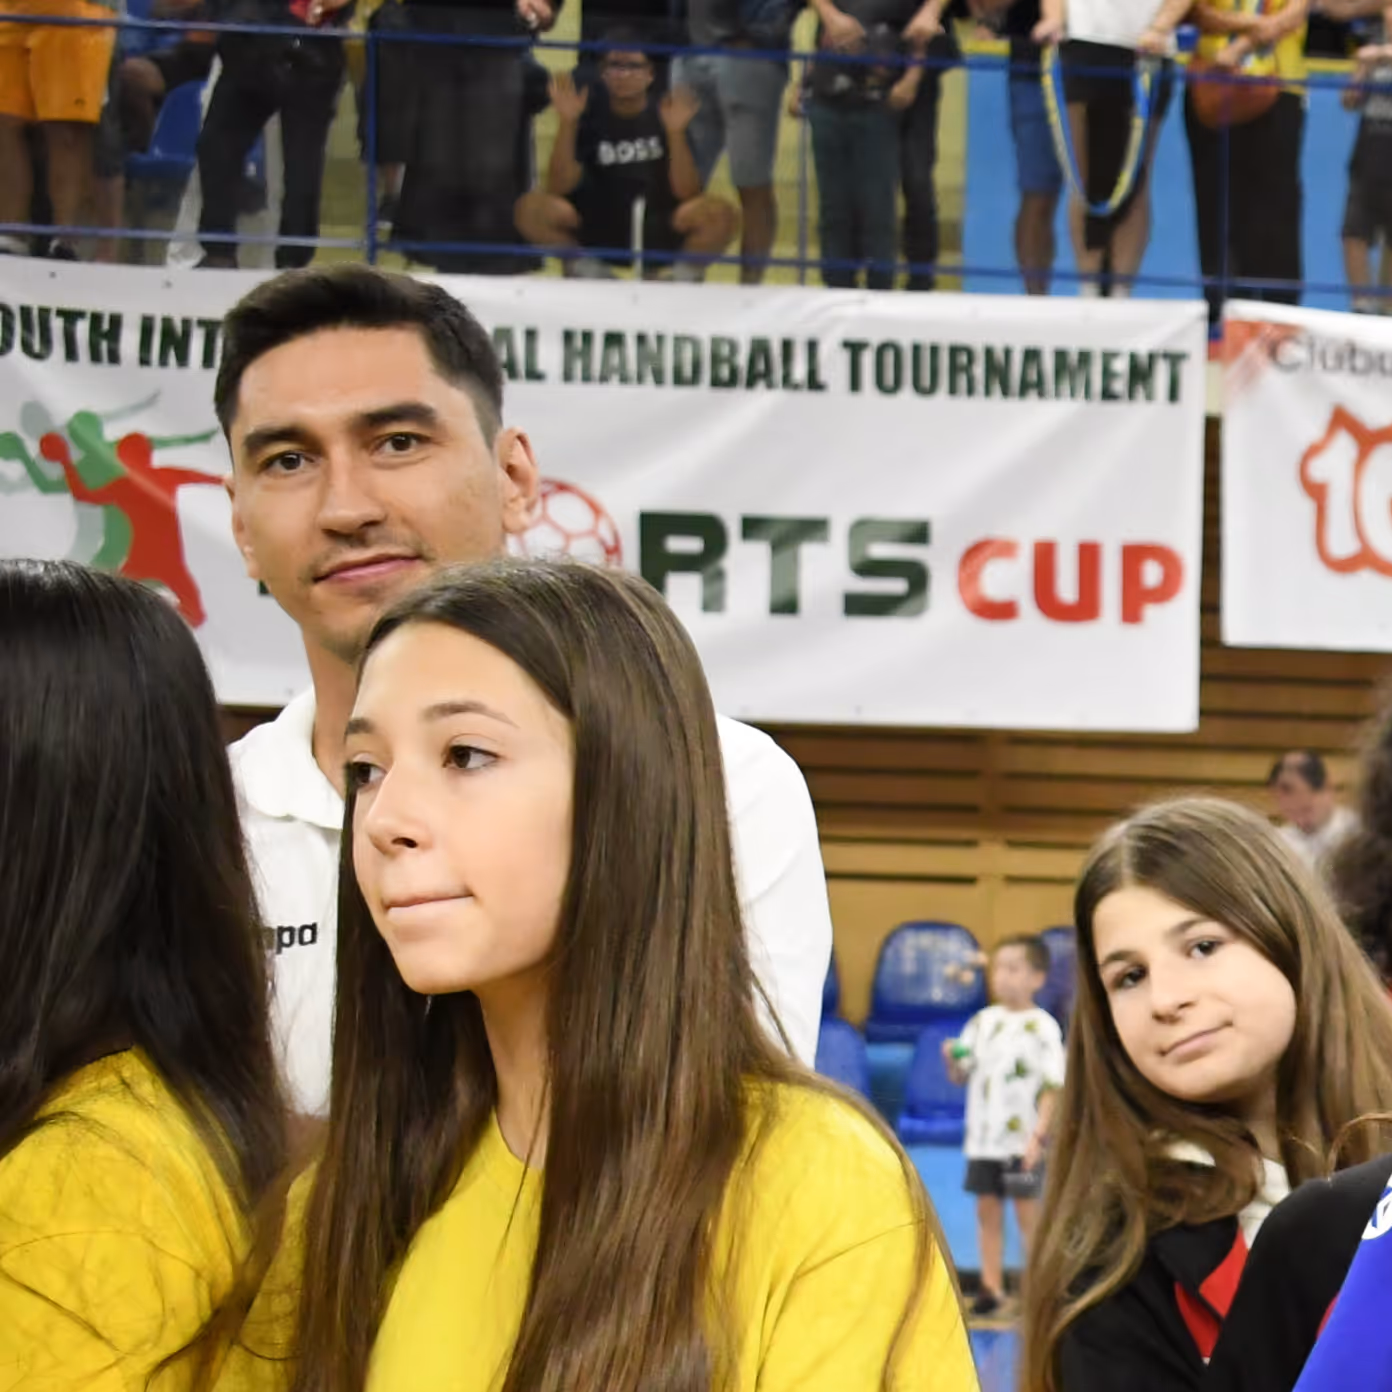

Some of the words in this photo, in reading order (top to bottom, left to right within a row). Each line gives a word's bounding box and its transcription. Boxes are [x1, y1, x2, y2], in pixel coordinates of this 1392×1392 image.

[561, 329, 827, 392] HANDBALL
[841, 339, 1189, 404] TOURNAMENT
[957, 537, 1186, 625] CUP
